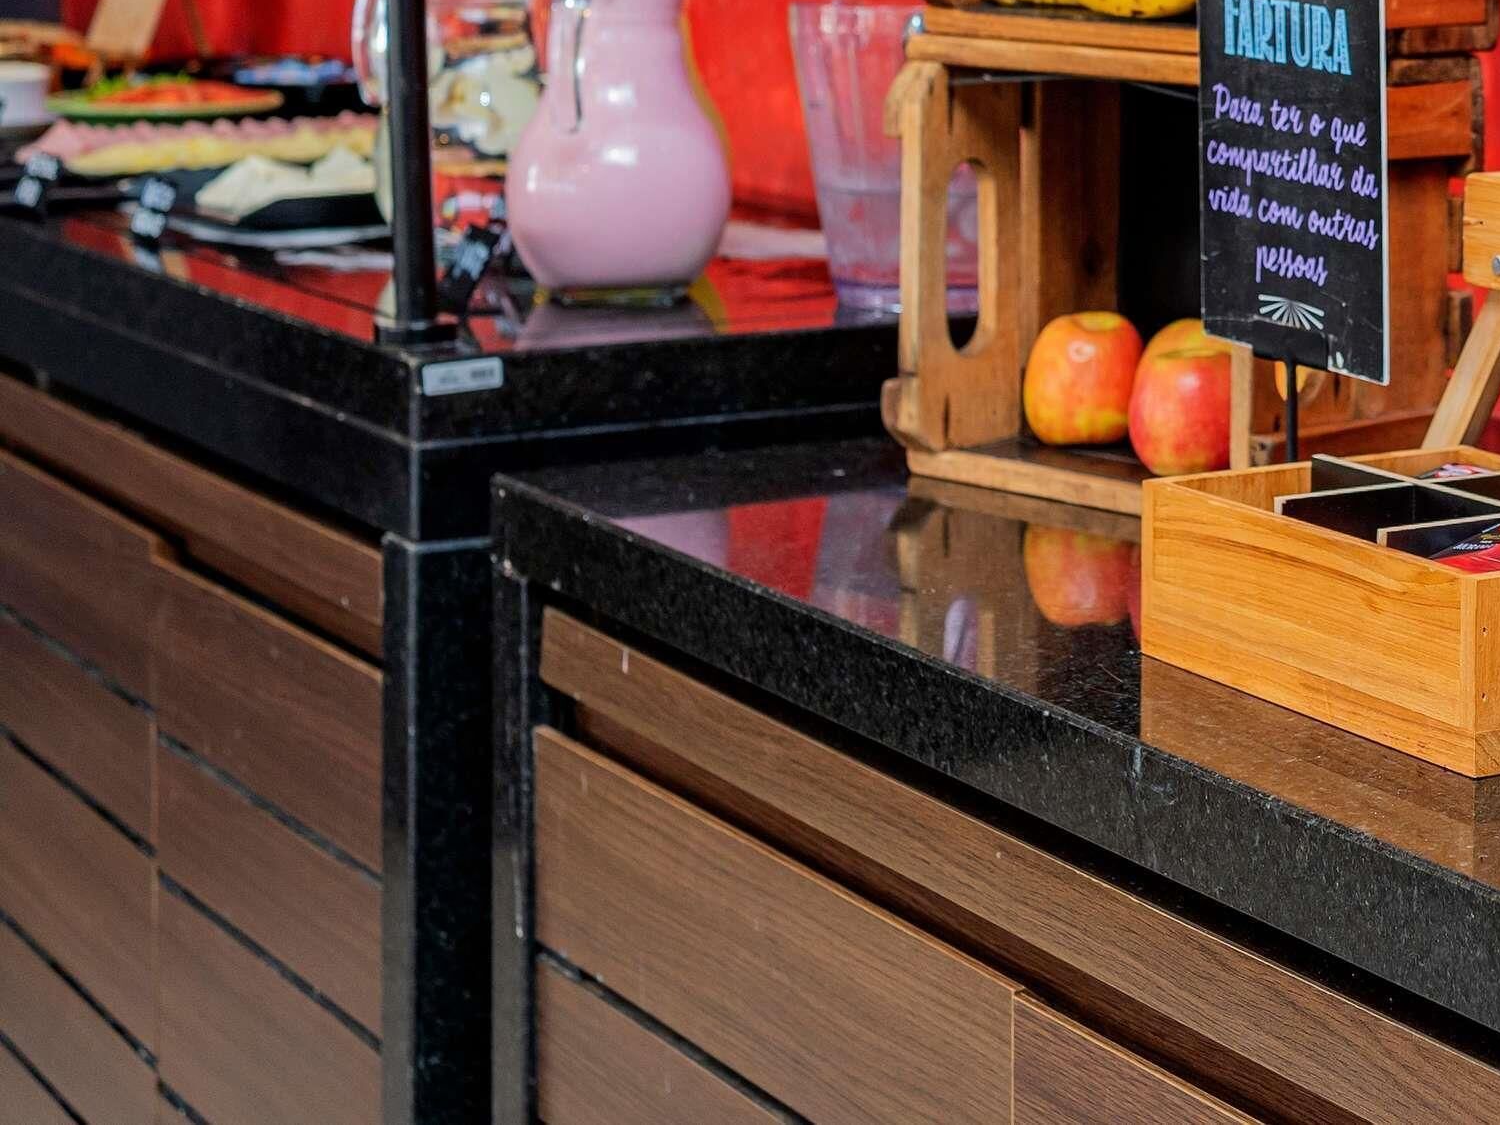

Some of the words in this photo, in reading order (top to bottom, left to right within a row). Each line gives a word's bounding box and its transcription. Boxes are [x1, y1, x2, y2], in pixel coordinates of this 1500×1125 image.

[1212, 82, 1265, 127] Para
[1270, 99, 1304, 135] ter
[1309, 113, 1326, 137] o
[1330, 116, 1368, 155] que
[1206, 139, 1345, 187] compartilhar
[1350, 164, 1379, 200] da
[1208, 185, 1254, 219] vida
[1257, 197, 1304, 230] com
[1307, 208, 1380, 251] outras
[1255, 245, 1328, 287] pessoas
